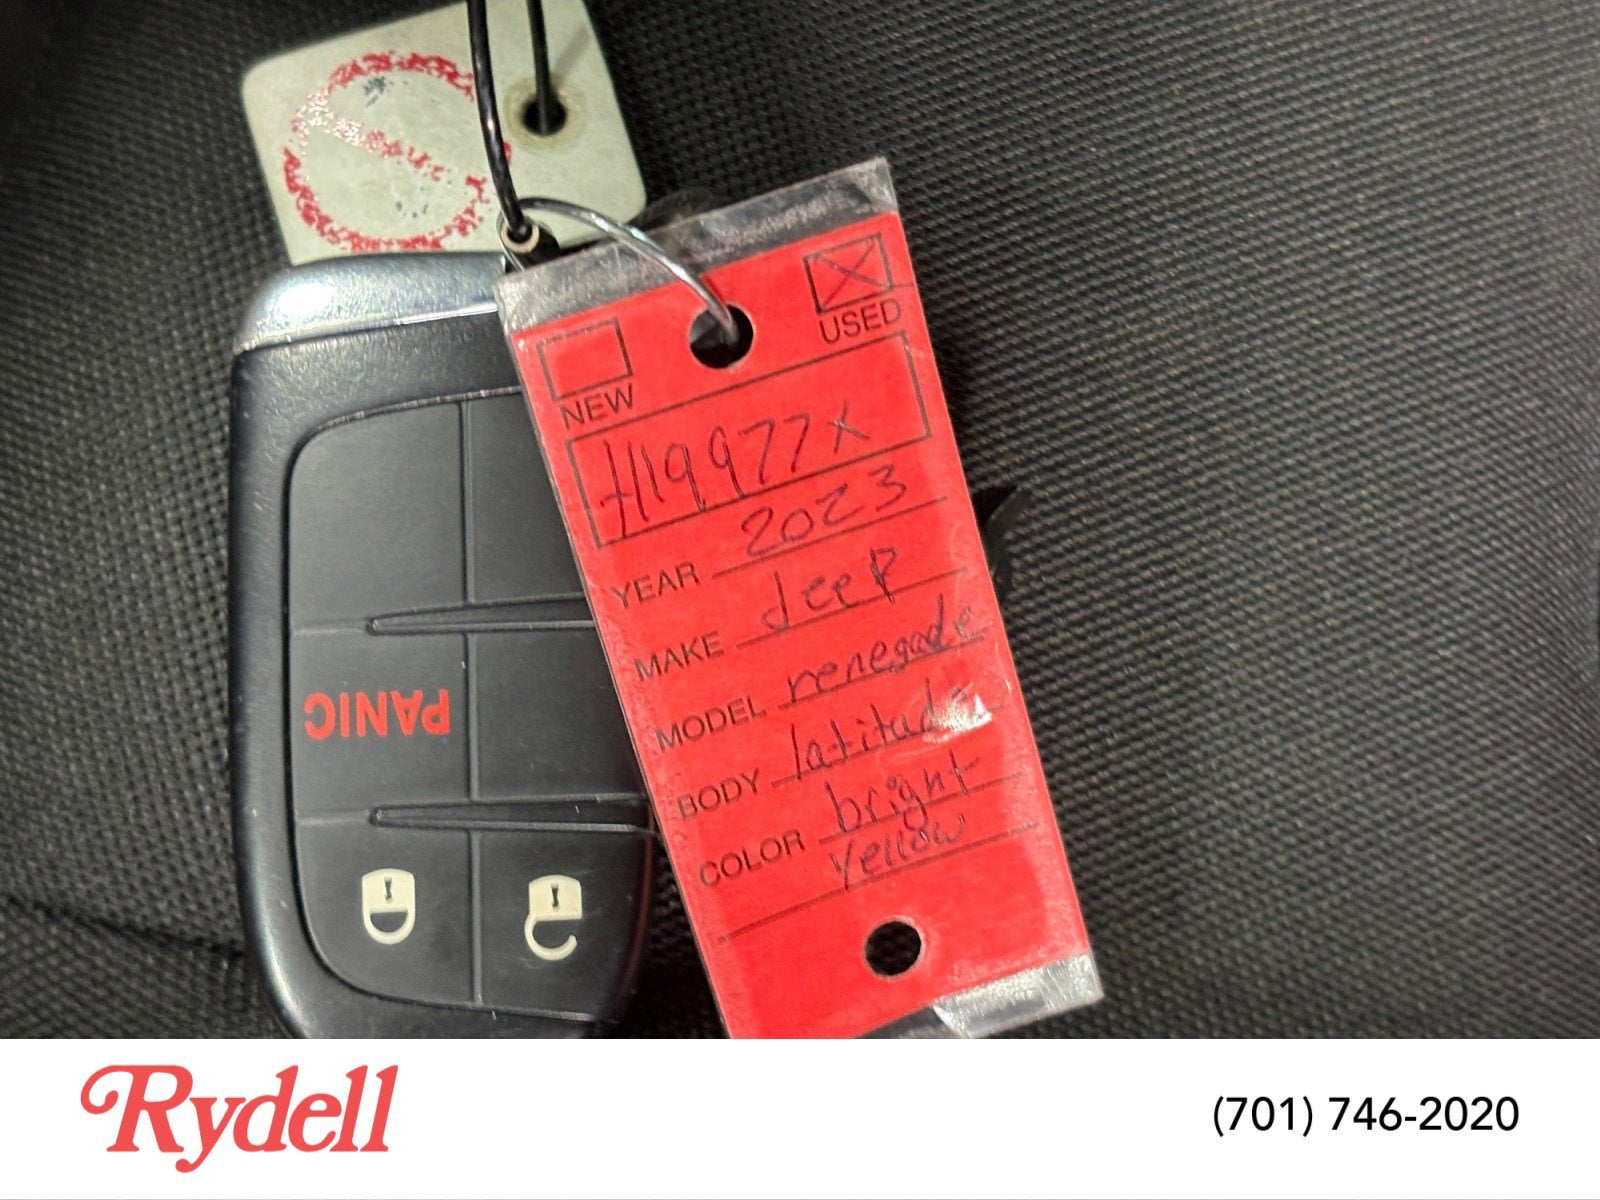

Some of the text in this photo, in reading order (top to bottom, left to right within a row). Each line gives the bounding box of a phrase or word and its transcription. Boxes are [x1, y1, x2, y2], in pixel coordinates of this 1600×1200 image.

[818, 298, 902, 345] USED
[560, 385, 635, 429] NEW
[741, 464, 907, 556] 2023
[611, 563, 700, 609] YEAR
[634, 632, 725, 682] MAKE
[304, 689, 451, 741] PANIC
[654, 695, 766, 753] MODEL
[677, 769, 760, 822] BODY
[699, 831, 806, 888] COLOR
